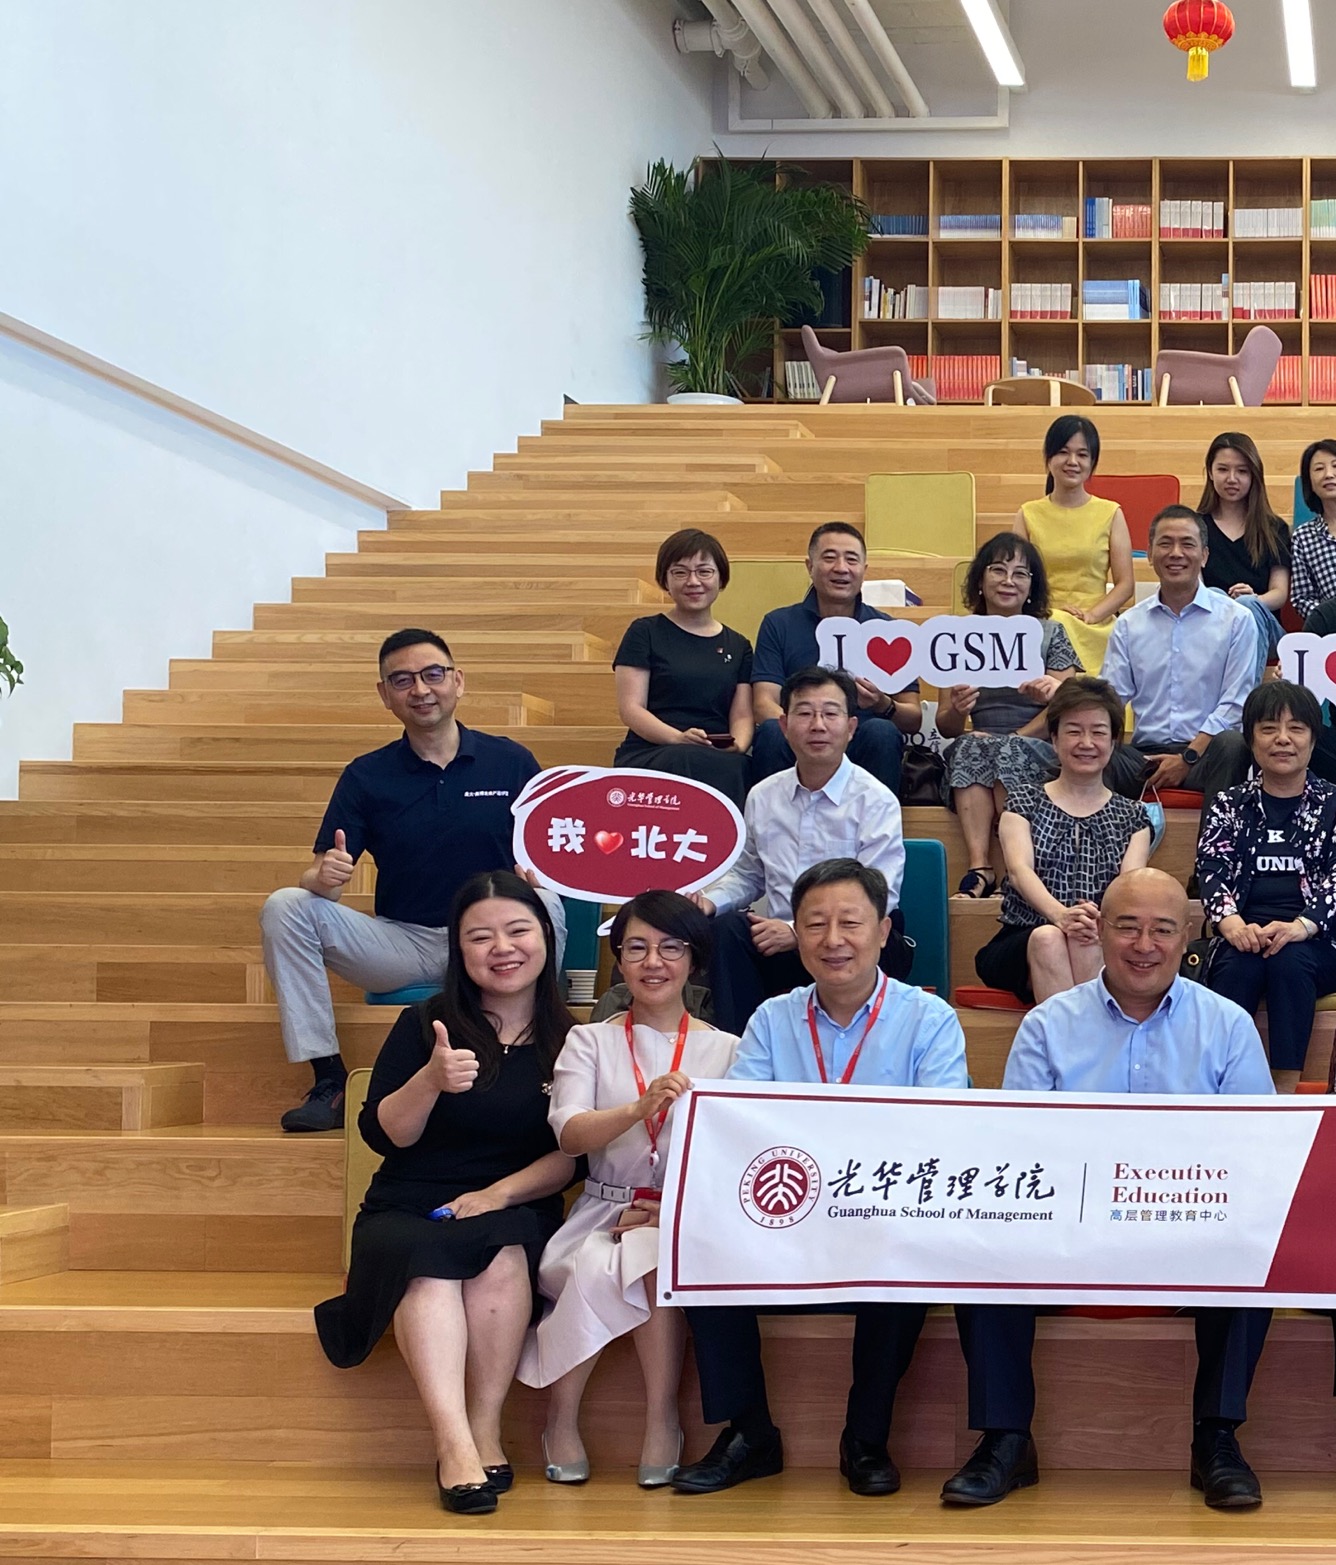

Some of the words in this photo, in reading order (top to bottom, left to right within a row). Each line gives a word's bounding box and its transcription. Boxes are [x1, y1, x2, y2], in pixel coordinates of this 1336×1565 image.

[833, 634, 847, 671] I
[930, 632, 1028, 672] GSM
[1294, 649, 1309, 686] I
[547, 817, 586, 854] 我
[630, 825, 709, 864] 北大
[743, 1157, 766, 1204] PEKING
[771, 1148, 819, 1202] UNIVERSITY
[828, 1158, 1055, 1204] 光华管理学院
[1113, 1162, 1229, 1181] Executive
[1111, 1187, 1229, 1204] Education
[760, 1216, 795, 1226] 1898
[827, 1205, 897, 1219] Guanghua
[899, 1206, 945, 1219] School
[949, 1207, 963, 1219] of
[965, 1208, 1054, 1223] Management
[1110, 1208, 1228, 1223] 高层管理教育中心
